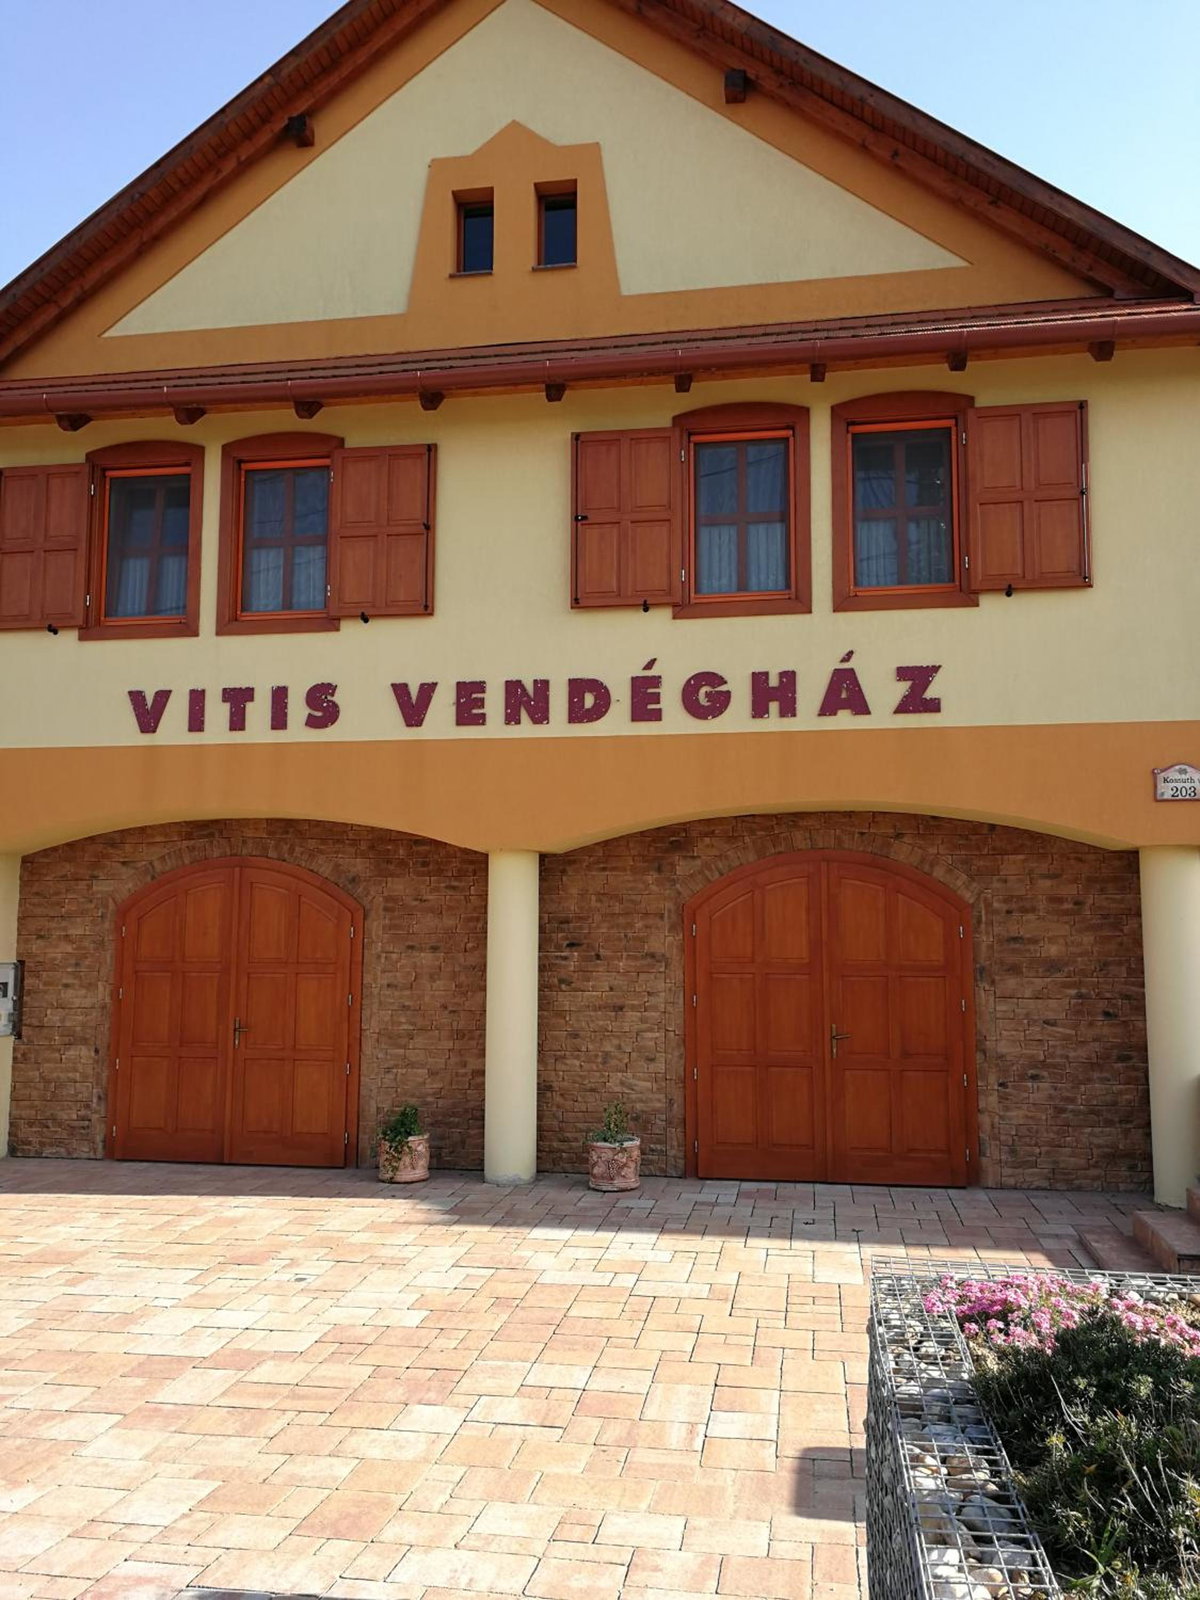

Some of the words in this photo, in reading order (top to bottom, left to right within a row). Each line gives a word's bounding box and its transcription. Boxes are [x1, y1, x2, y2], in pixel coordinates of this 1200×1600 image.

[127, 682, 340, 735] VITIS
[390, 649, 943, 728] VENDÉGHÁZ
[1171, 785, 1197, 798] 203
